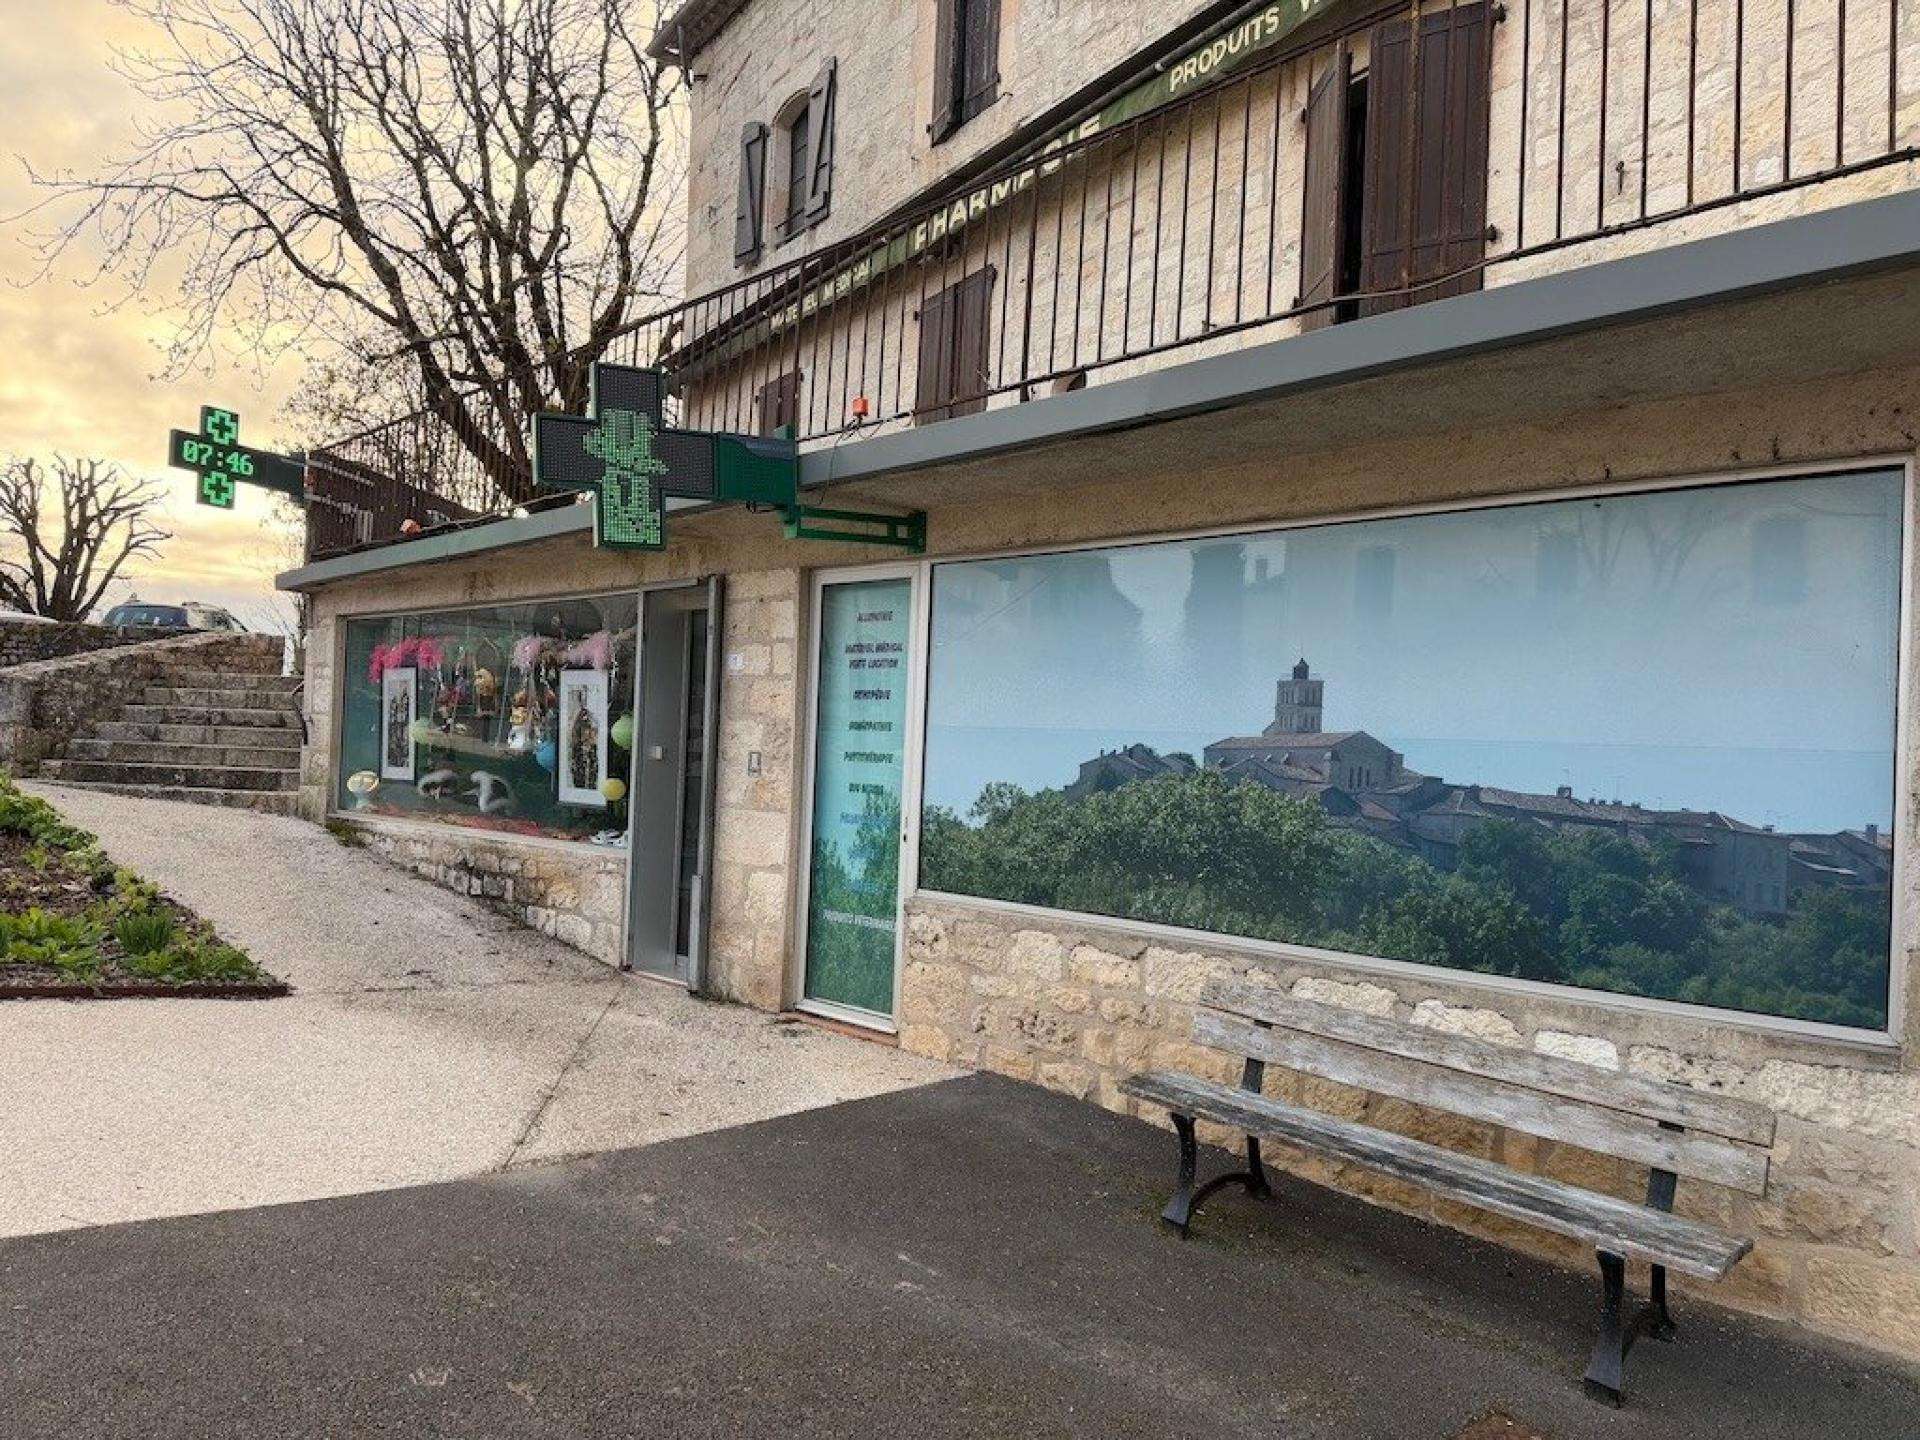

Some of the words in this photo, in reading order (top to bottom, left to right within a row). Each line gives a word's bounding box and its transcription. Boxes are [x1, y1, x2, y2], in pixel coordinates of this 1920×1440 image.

[1169, 6, 1281, 92] PRODUITS
[914, 115, 1101, 250] PHARMACIE
[183, 440, 254, 475] 07:46
